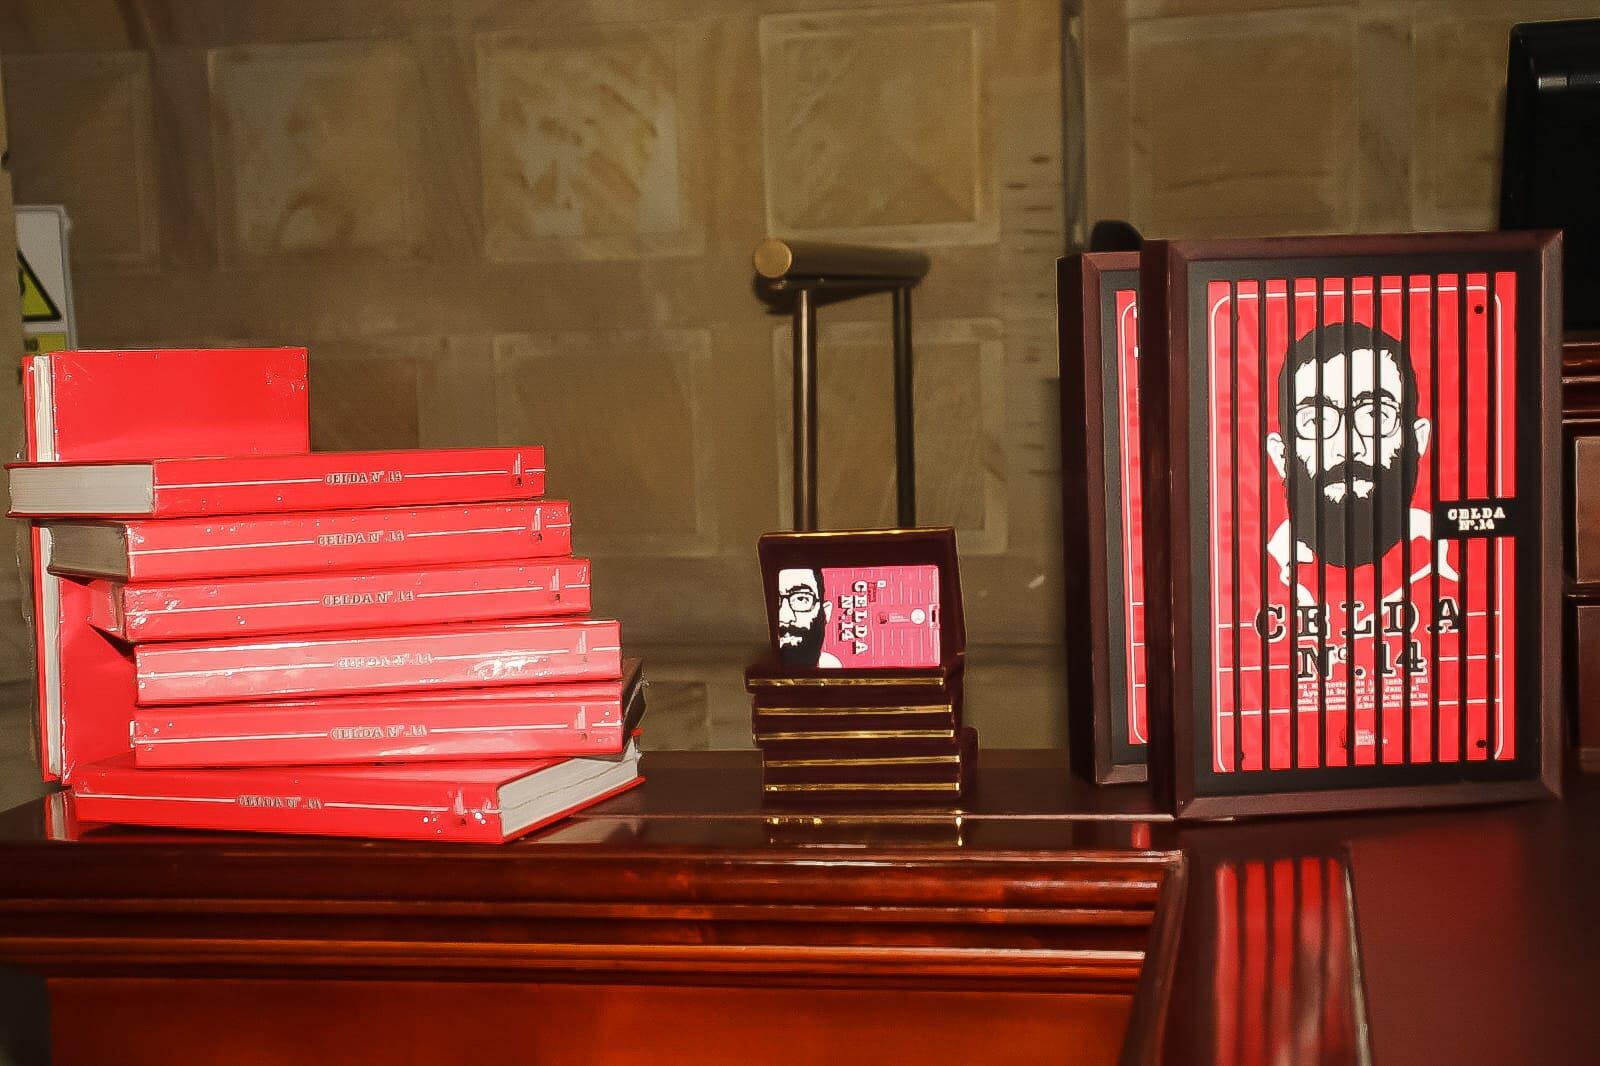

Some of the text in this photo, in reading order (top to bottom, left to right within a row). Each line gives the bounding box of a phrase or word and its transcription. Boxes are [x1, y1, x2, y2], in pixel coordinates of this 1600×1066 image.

[325, 473, 368, 485] CELDA
[1448, 507, 1506, 520] CELDA
[317, 533, 365, 546] CELDA
[322, 594, 373, 607] CELDA
[852, 580, 869, 655] CELDA
[1255, 598, 1466, 642] CELDA
